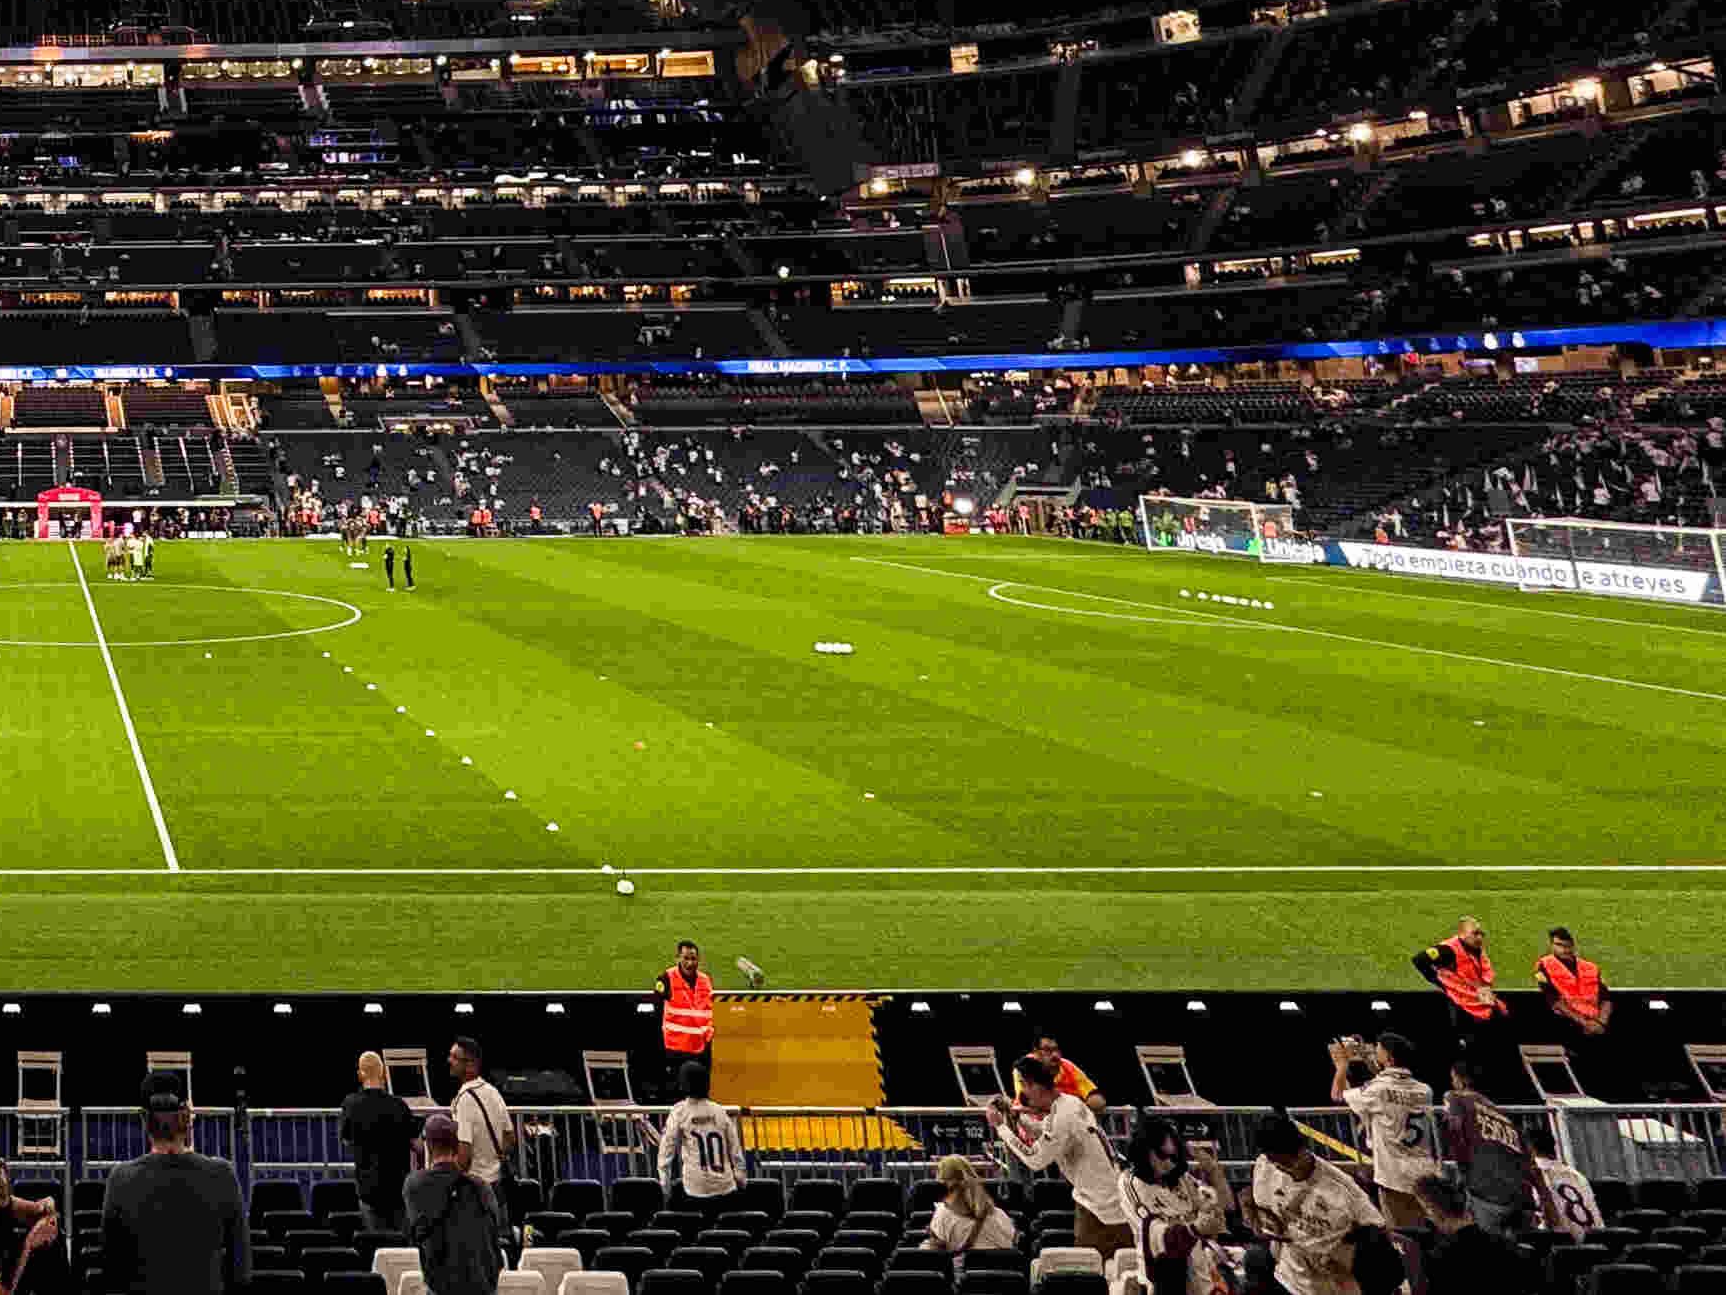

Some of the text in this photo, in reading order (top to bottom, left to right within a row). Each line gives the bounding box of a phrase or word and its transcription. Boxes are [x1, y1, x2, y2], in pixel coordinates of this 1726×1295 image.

[1409, 554, 1486, 578] empieza
[1600, 571, 1685, 595] atreves
[690, 1130, 724, 1173] 10
[1557, 1183, 1594, 1227] 8
